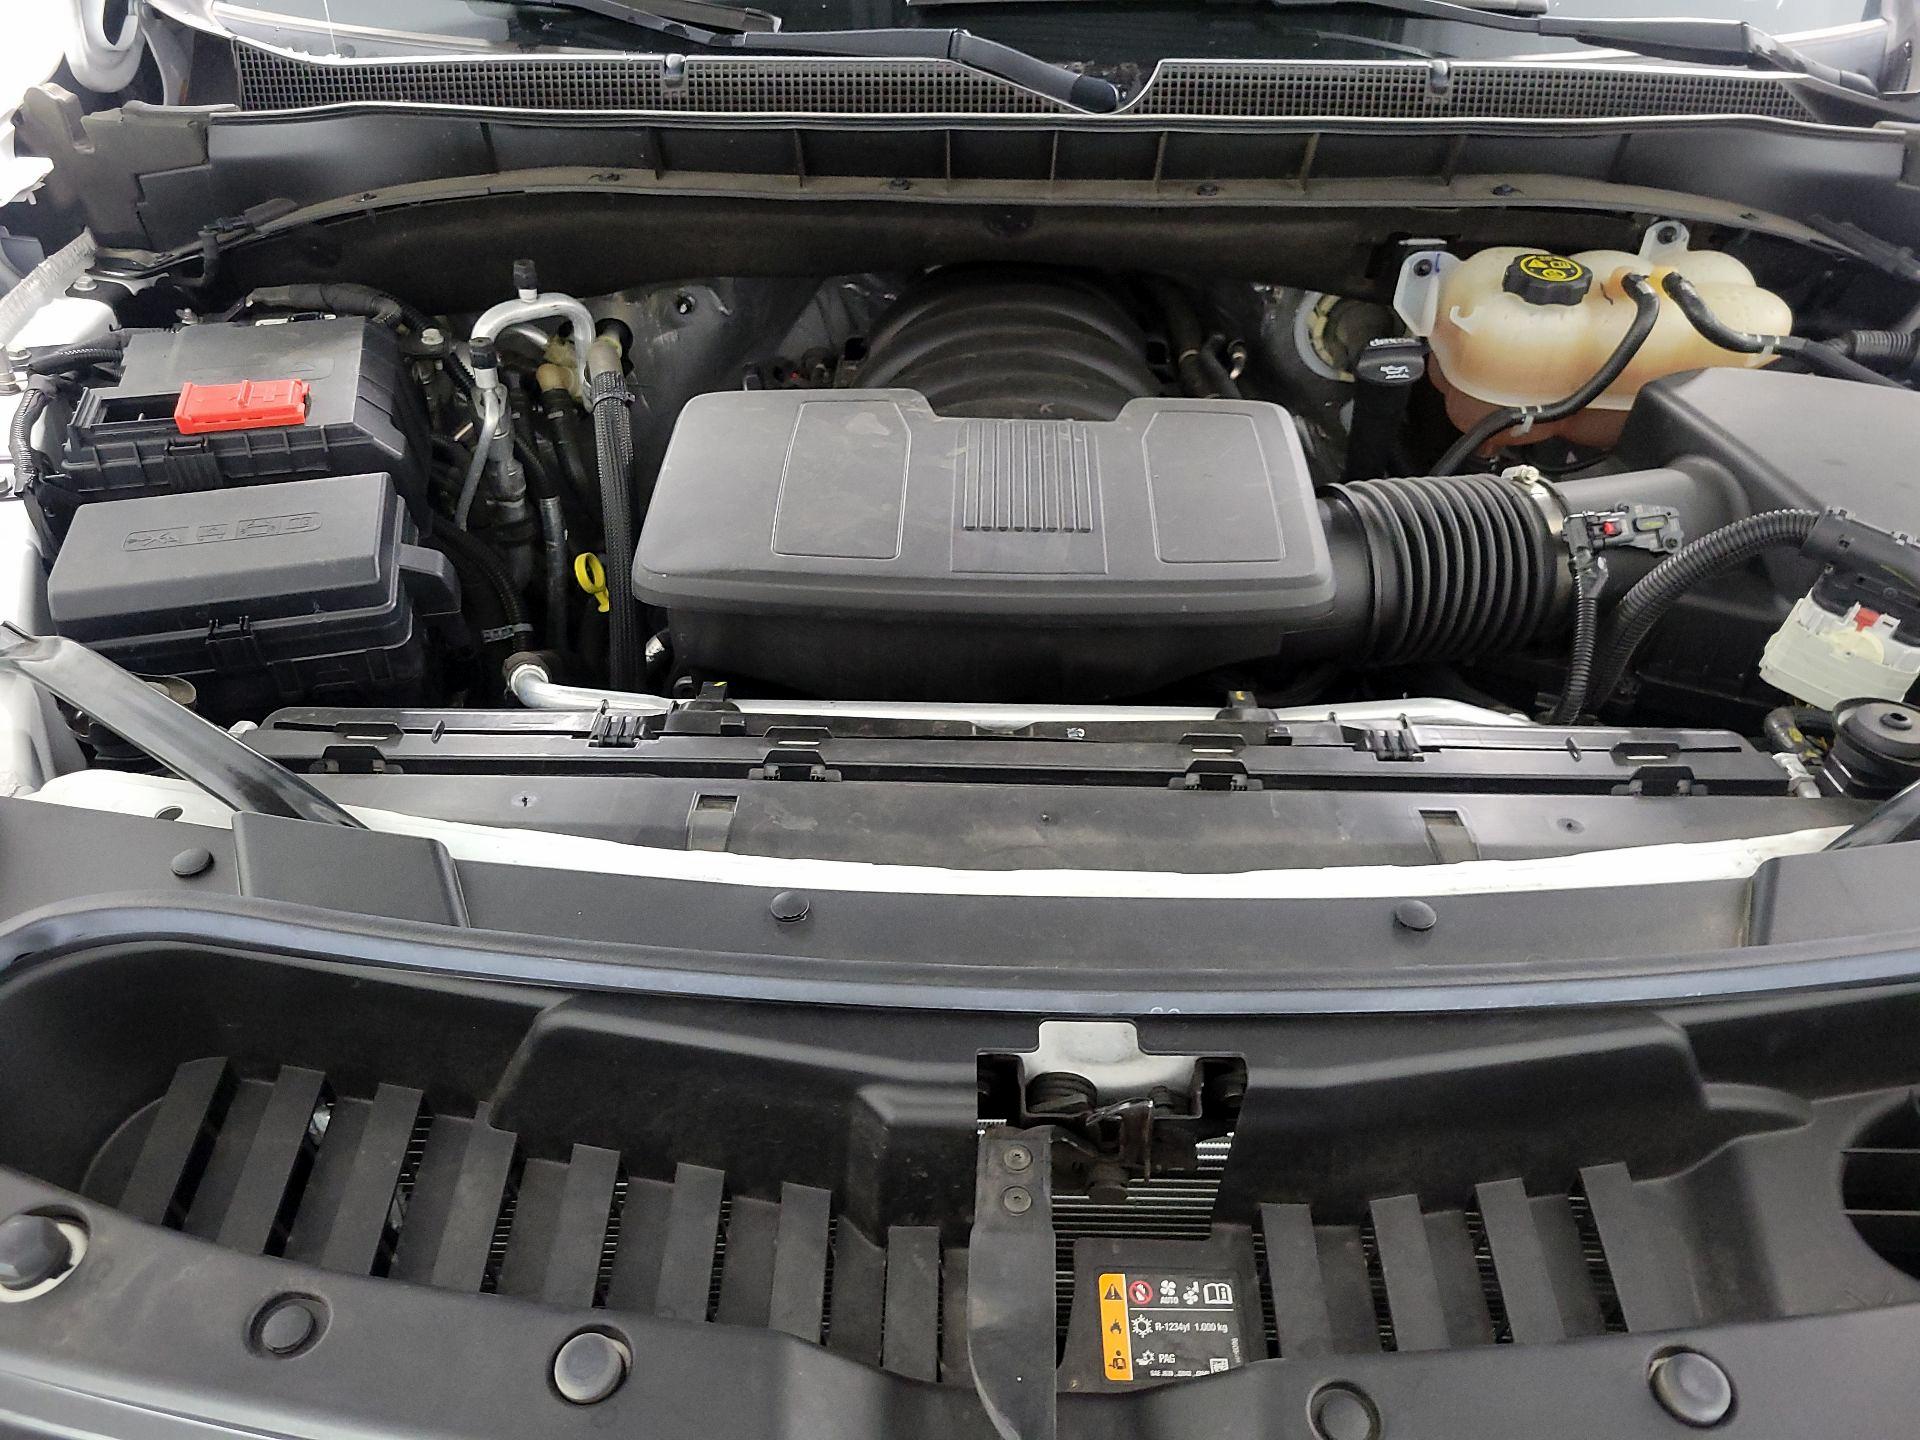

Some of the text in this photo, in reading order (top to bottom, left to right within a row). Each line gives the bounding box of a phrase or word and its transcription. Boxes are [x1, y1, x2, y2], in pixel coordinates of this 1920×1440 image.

[1160, 1296, 1179, 1304] AUTO
[1155, 1322, 1190, 1333] R-1234yf
[1217, 1322, 1228, 1334] kg
[1158, 1353, 1176, 1364] PAG
